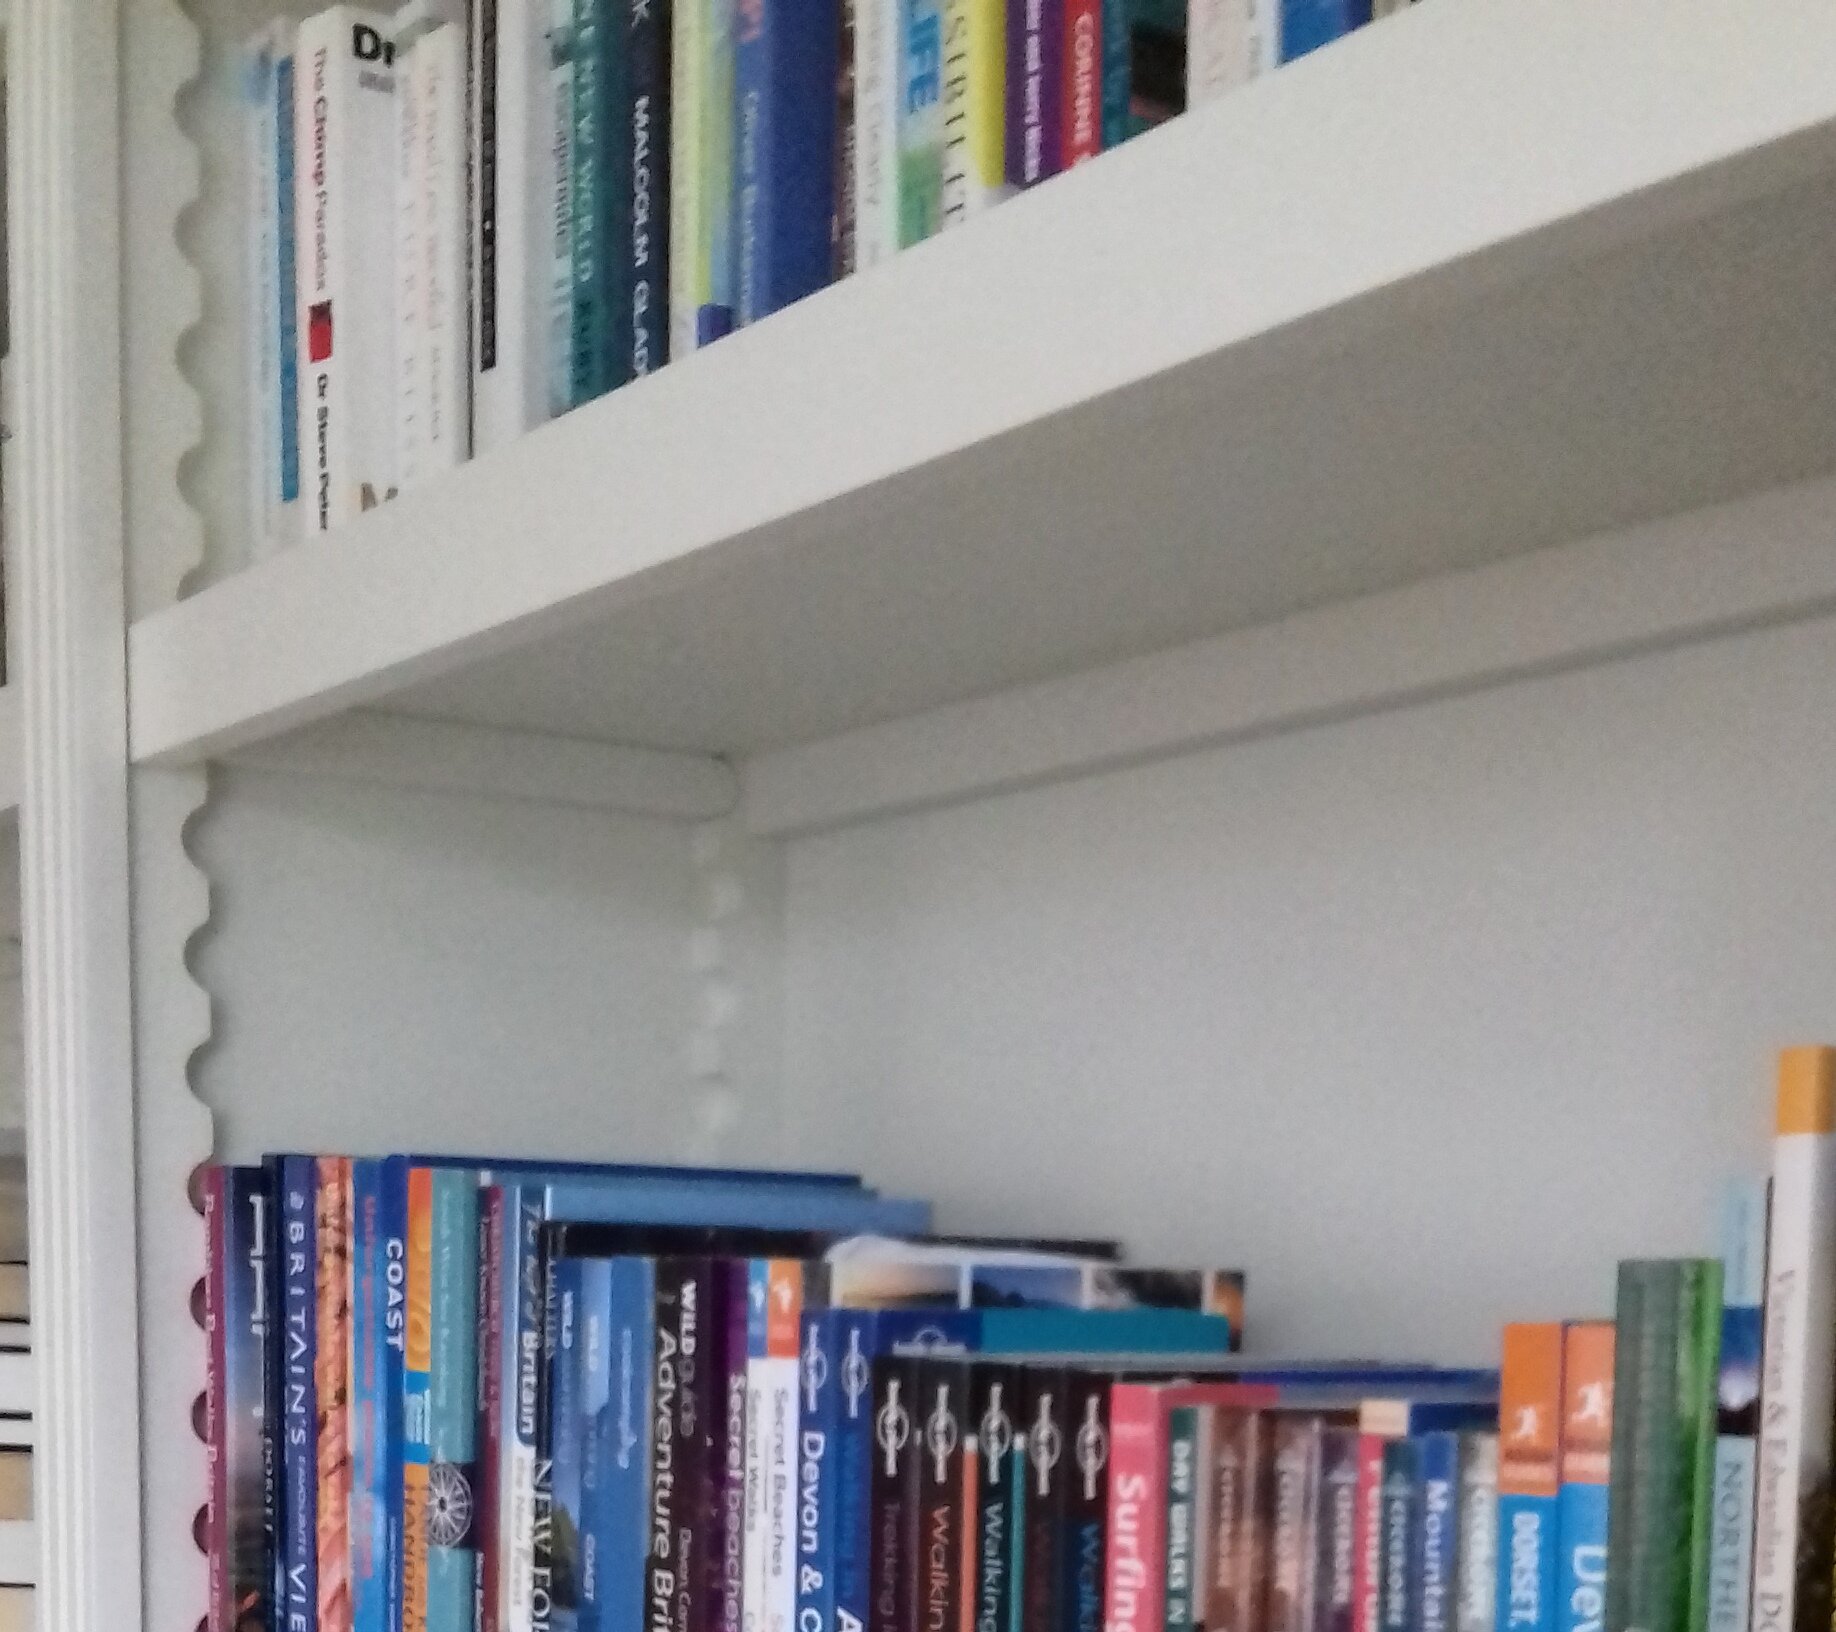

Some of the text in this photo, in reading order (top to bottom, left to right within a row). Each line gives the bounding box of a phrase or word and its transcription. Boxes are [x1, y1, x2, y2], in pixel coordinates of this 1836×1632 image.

[311, 96, 330, 187] Chimp
[633, 96, 651, 267] MALCOLM
[314, 191, 330, 292] Paradox
[316, 407, 331, 468] Steve
[290, 1221, 306, 1446] BRITAIN'S
[385, 1237, 404, 1354] COAST
[520, 1329, 542, 1435] Britain
[726, 1373, 748, 1480] Secret
[746, 1387, 761, 1459] Secret
[654, 1327, 677, 1559] Adventure
[772, 1387, 789, 1577] Secret Beaches
[800, 1430, 827, 1553] Devon
[1169, 1440, 1191, 1494] DAY
[531, 1459, 553, 1554] NEW
[1167, 1502, 1189, 1592] WALKS
[800, 1563, 825, 1596] &
